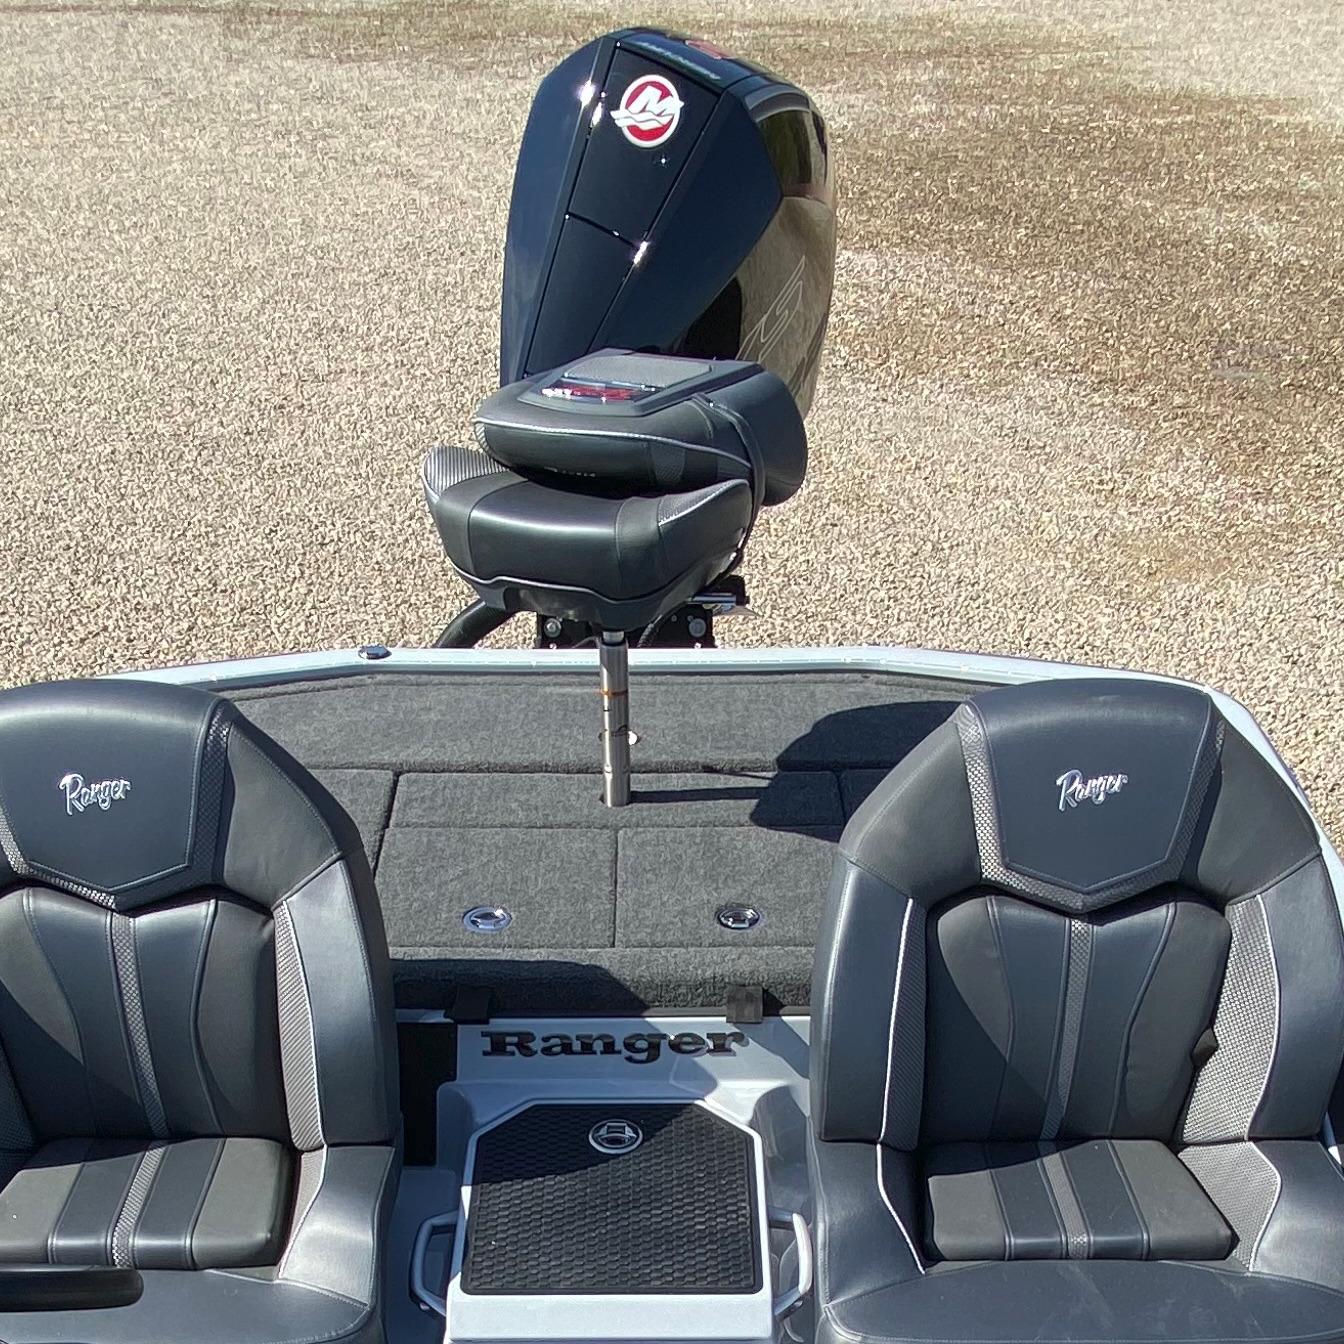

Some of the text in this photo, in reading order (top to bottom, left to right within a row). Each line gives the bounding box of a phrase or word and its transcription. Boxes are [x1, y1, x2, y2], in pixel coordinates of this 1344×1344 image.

[58, 773, 131, 815] Ranger
[1056, 769, 1128, 811] Ranger
[481, 1030, 750, 1064] Ranger
